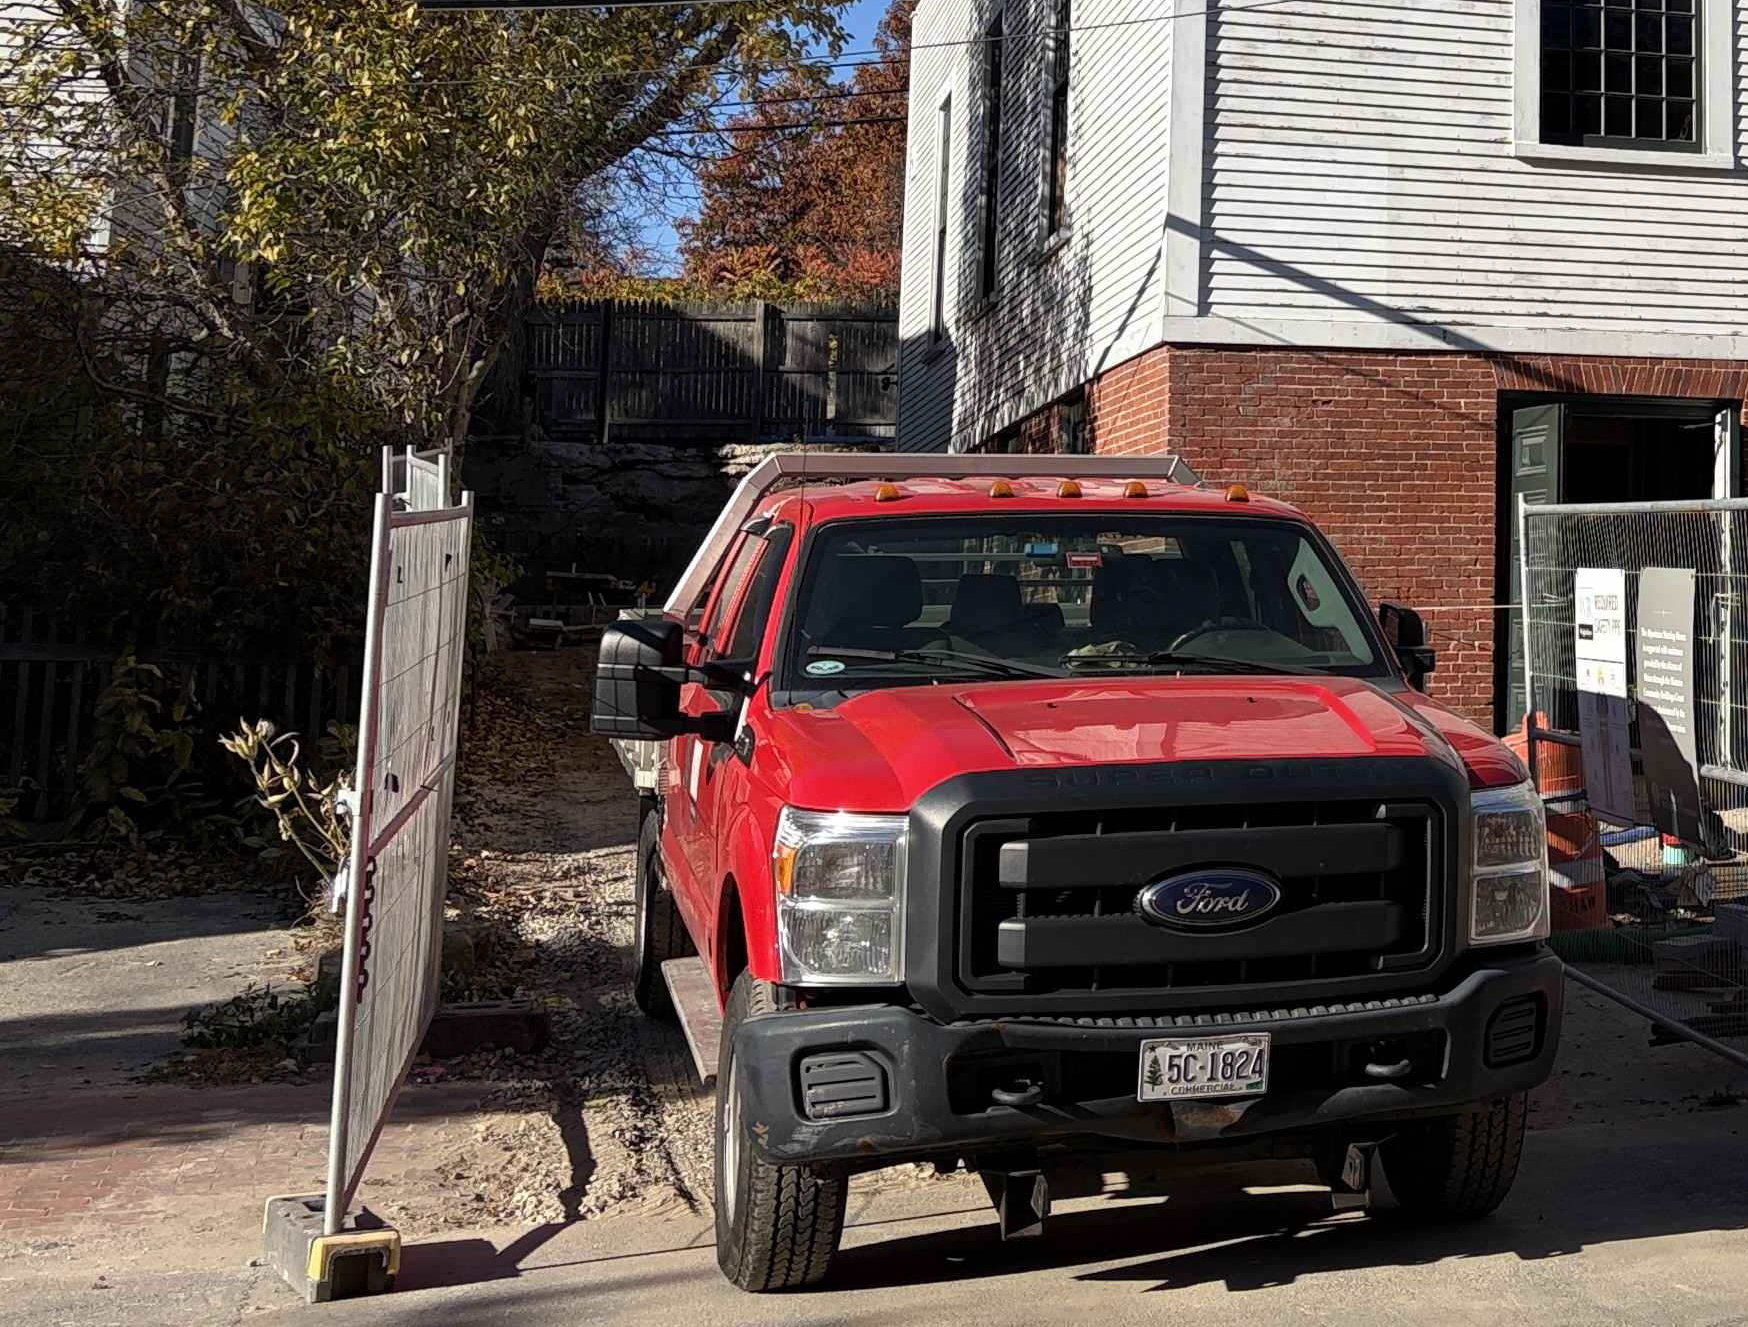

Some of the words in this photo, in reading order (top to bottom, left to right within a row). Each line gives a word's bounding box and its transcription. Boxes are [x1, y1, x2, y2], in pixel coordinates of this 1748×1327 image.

[1176, 883, 1249, 915] Ford
[1186, 1040, 1225, 1052] MAINE
[1170, 1082, 1236, 1097] COMMERCIAL
